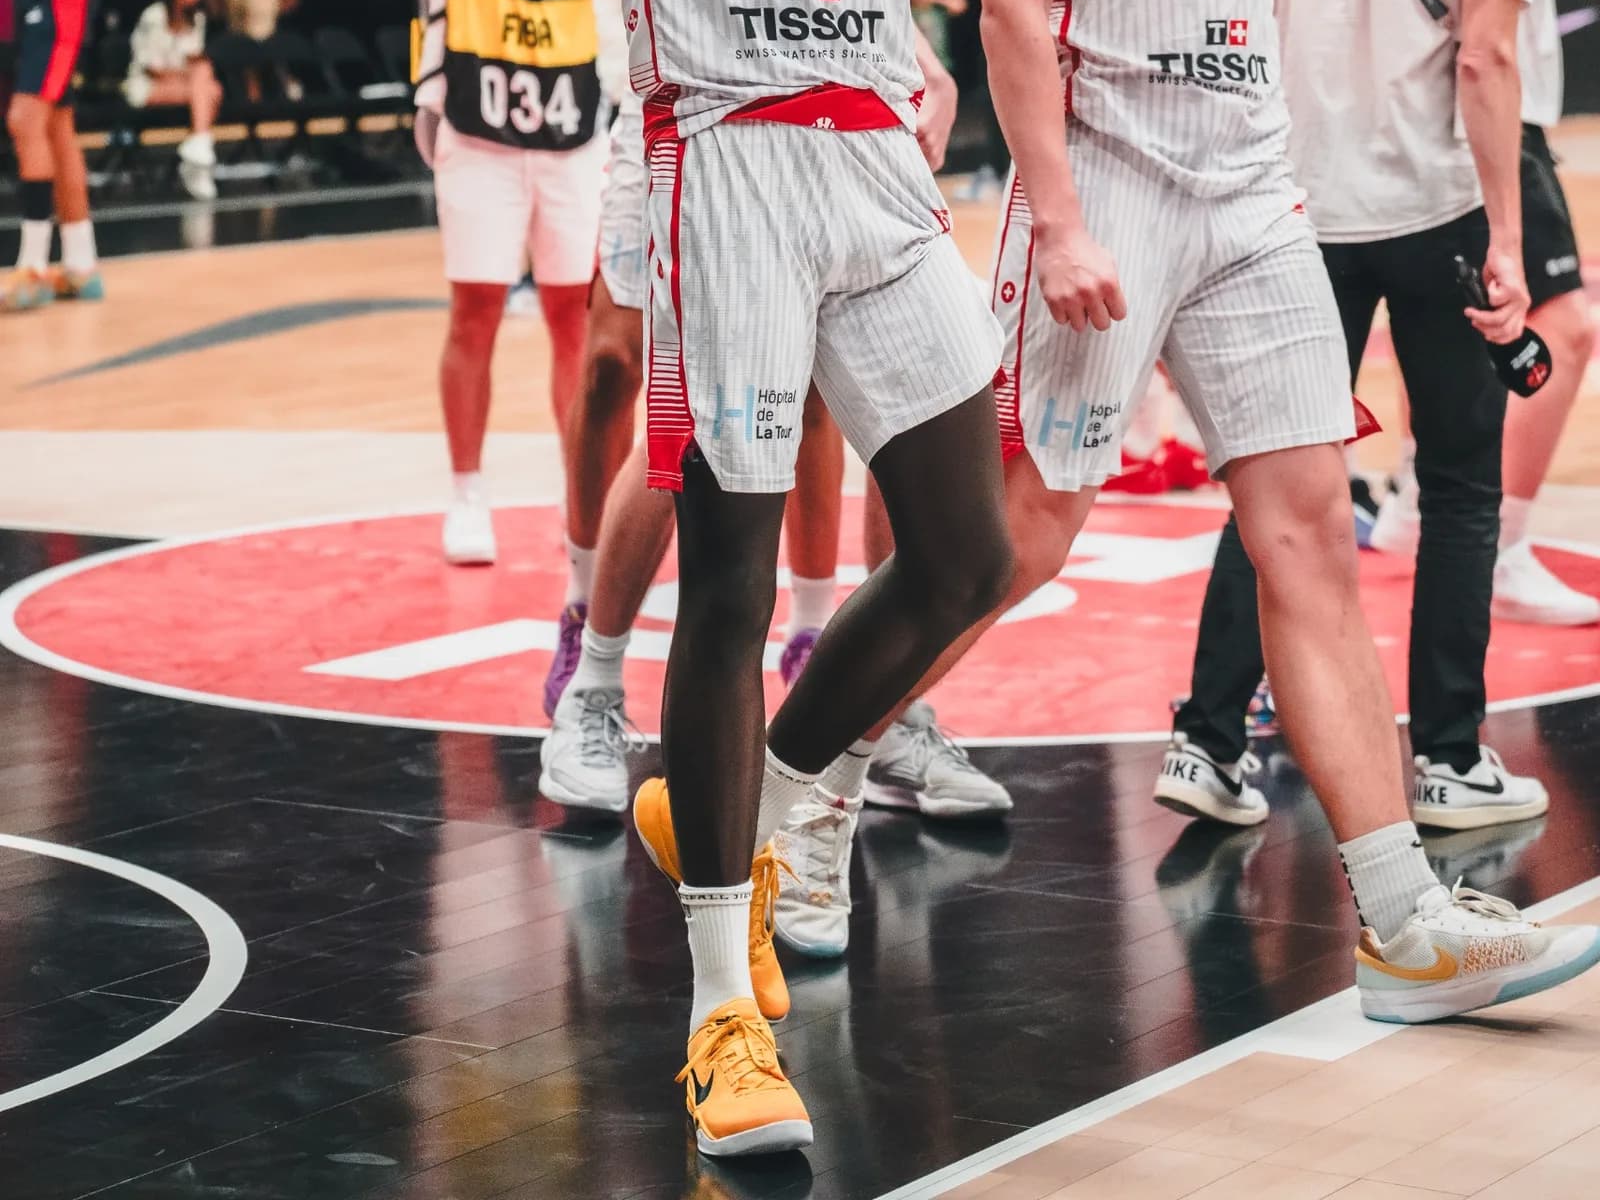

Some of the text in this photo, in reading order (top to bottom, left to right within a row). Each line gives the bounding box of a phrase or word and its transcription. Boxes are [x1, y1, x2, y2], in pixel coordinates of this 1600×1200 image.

[503, 13, 554, 48] FIBA
[729, 6, 885, 44] TISSOT
[1206, 20, 1227, 45] T
[1147, 52, 1270, 84] TISSOT
[480, 65, 582, 135] 034
[758, 388, 797, 406] Hôpital
[757, 408, 774, 422] de
[756, 425, 773, 440] La
[1083, 435, 1099, 448] La
[1162, 759, 1199, 783] IKE
[1414, 784, 1447, 804] IKE
